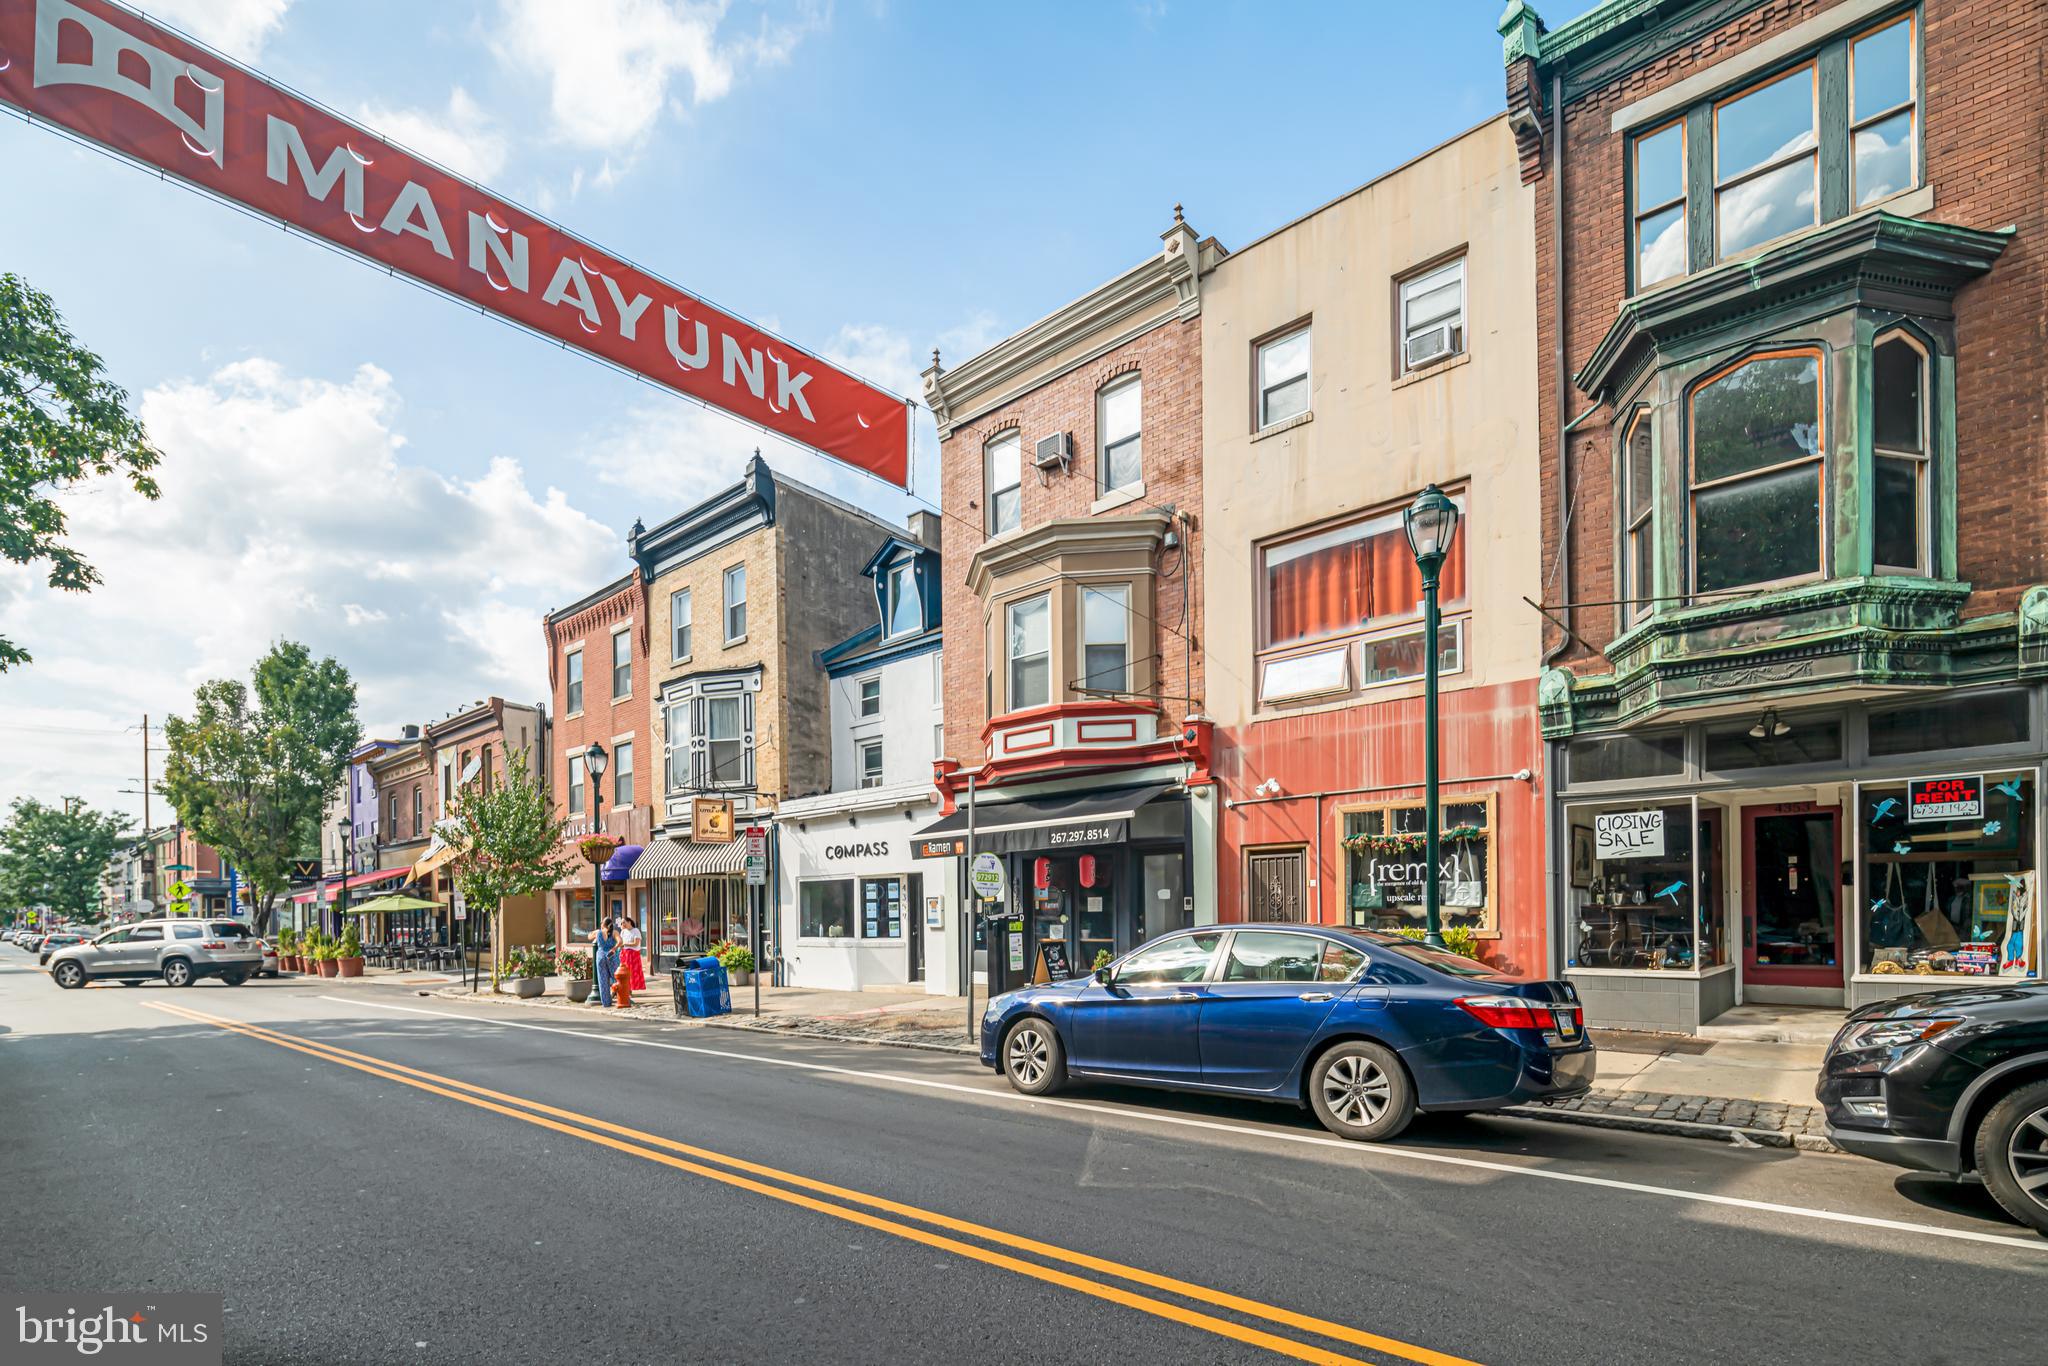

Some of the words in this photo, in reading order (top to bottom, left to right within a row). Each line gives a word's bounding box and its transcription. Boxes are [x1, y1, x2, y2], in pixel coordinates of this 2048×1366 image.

[267, 113, 816, 423] MANAYUNK
[1925, 779, 1965, 792] FOR
[1915, 789, 1977, 804] RENT
[590, 819, 607, 835] SA
[1051, 828, 1110, 844] 267.297.8514
[1598, 829, 1655, 848] SALE
[825, 841, 889, 860] COMPASS
[928, 842, 951, 853] Ramen
[1386, 892, 1416, 903] upscale
